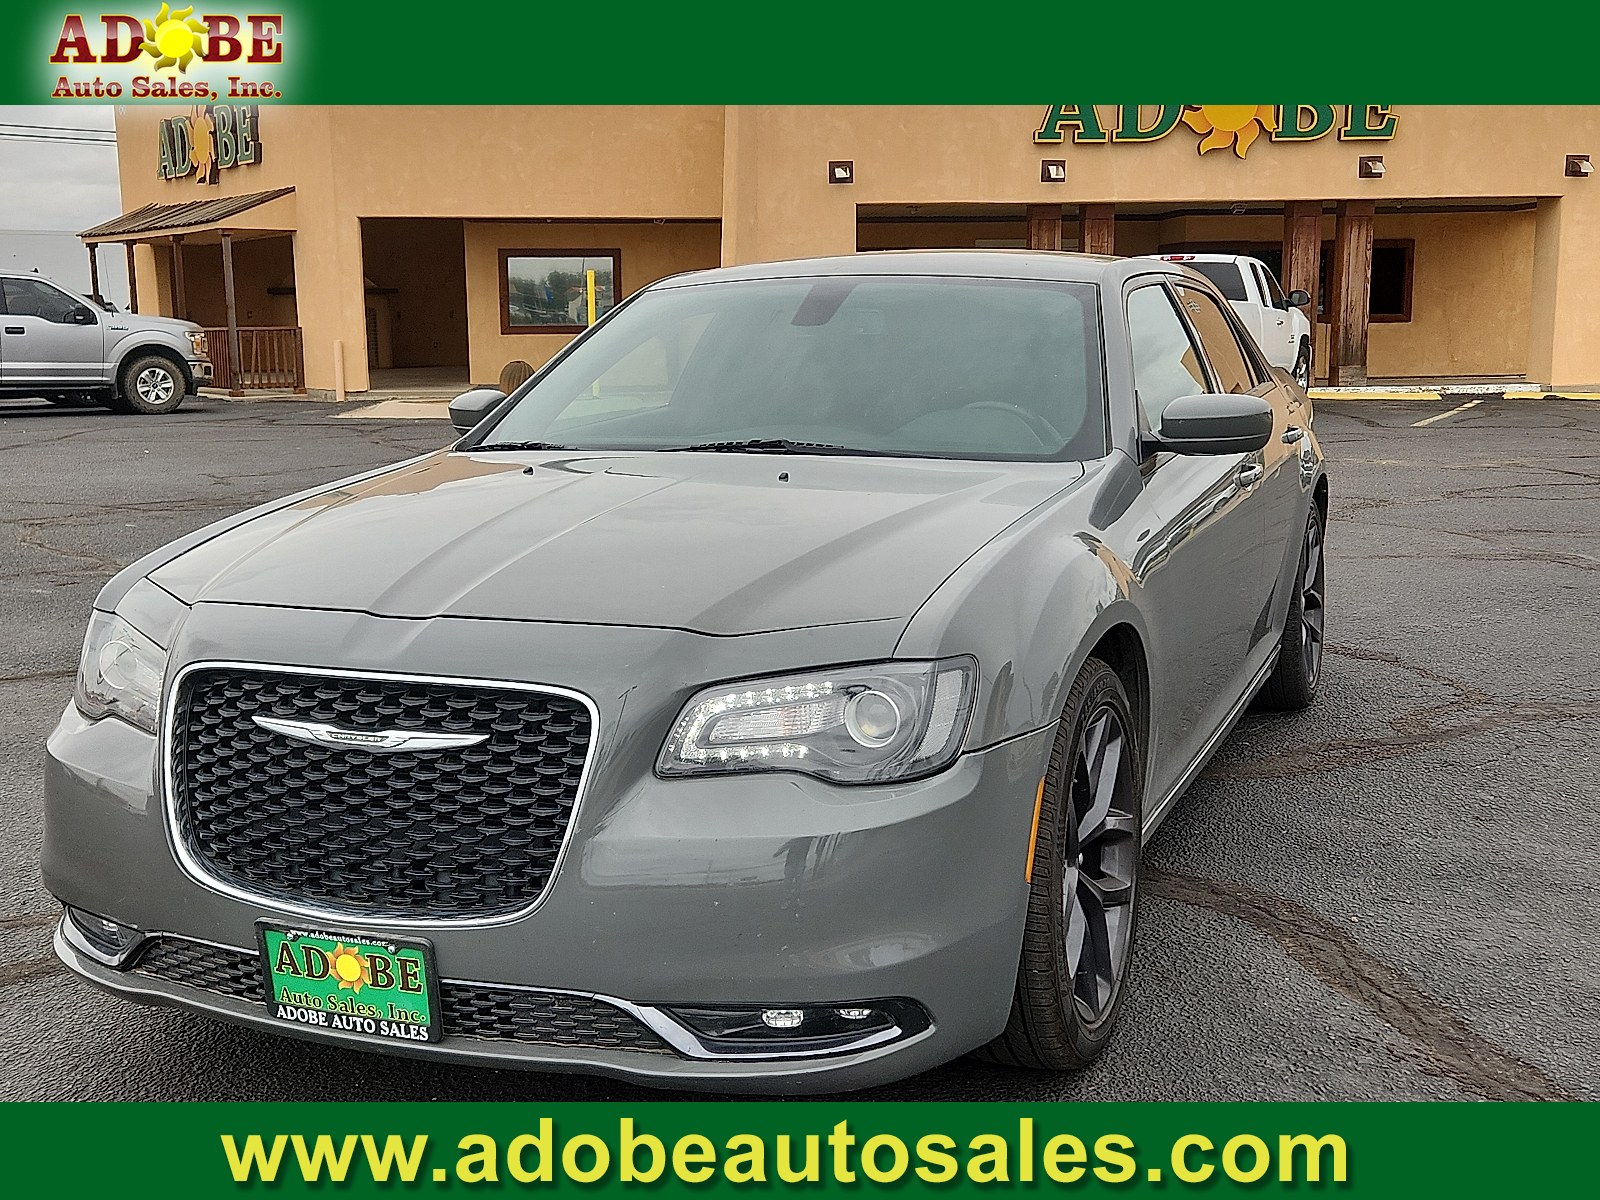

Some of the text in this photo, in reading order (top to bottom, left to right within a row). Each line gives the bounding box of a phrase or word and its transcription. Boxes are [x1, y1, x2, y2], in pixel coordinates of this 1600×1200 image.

[279, 986, 428, 1023] Auto Sales, Inc.
[276, 1005, 429, 1042] ADOBE AUTO SALES
